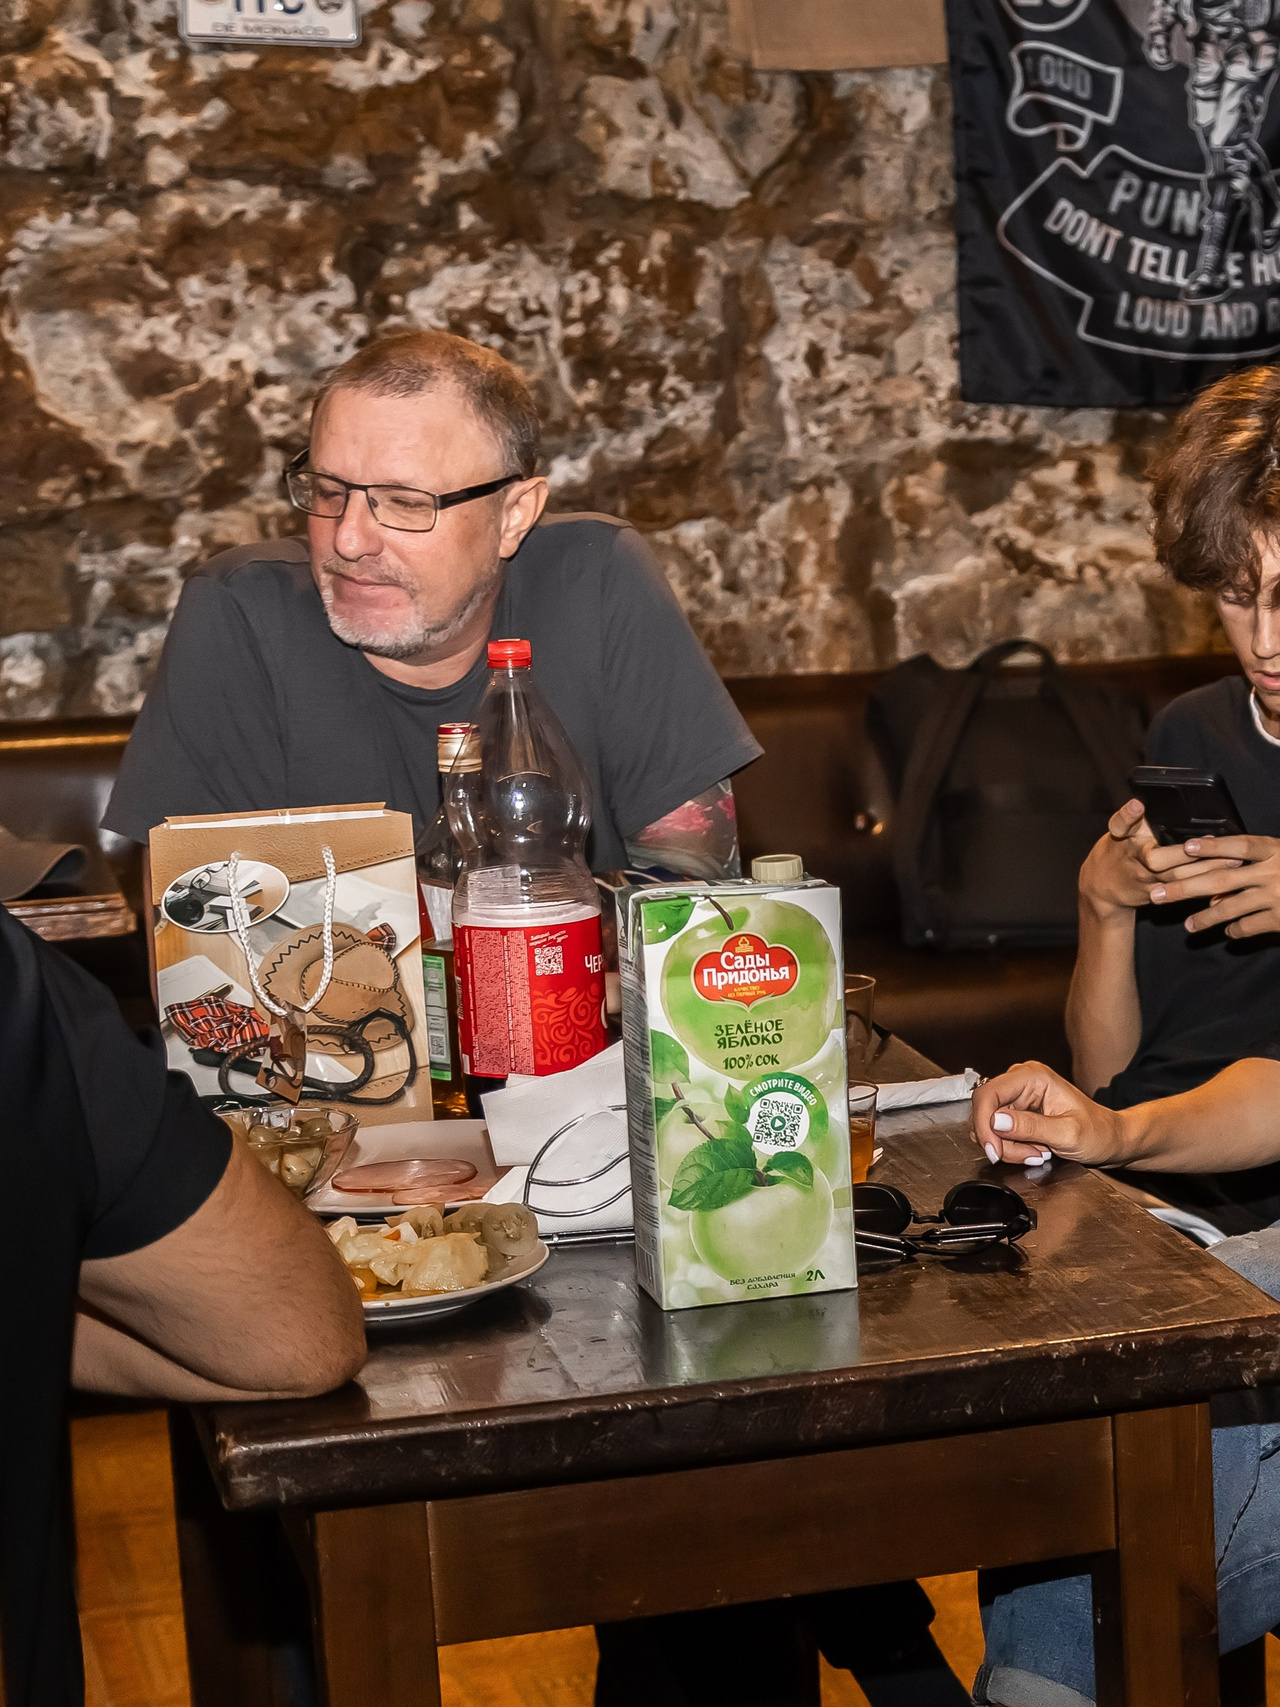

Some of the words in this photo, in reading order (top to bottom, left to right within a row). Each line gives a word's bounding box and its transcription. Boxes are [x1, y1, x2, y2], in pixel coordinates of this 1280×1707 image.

[1107, 170, 1202, 237] PUN
[1043, 197, 1124, 264] DONT
[1126, 235, 1190, 288] TELL
[1114, 290, 1192, 339] LOUD
[1200, 302, 1259, 341] AND
[720, 951, 770, 970] Сады
[702, 966, 790, 990] Придонья
[714, 1019, 785, 1037] ЗЕЛЁНОЕ
[716, 1032, 783, 1050] ЯБЛОКО
[722, 1053, 754, 1070] 100%
[755, 1053, 780, 1067] СОК
[749, 1078, 794, 1097] СМОТРИТЕ
[793, 1081, 818, 1106] ВИДЕО
[805, 1269, 826, 1282] 2Л
